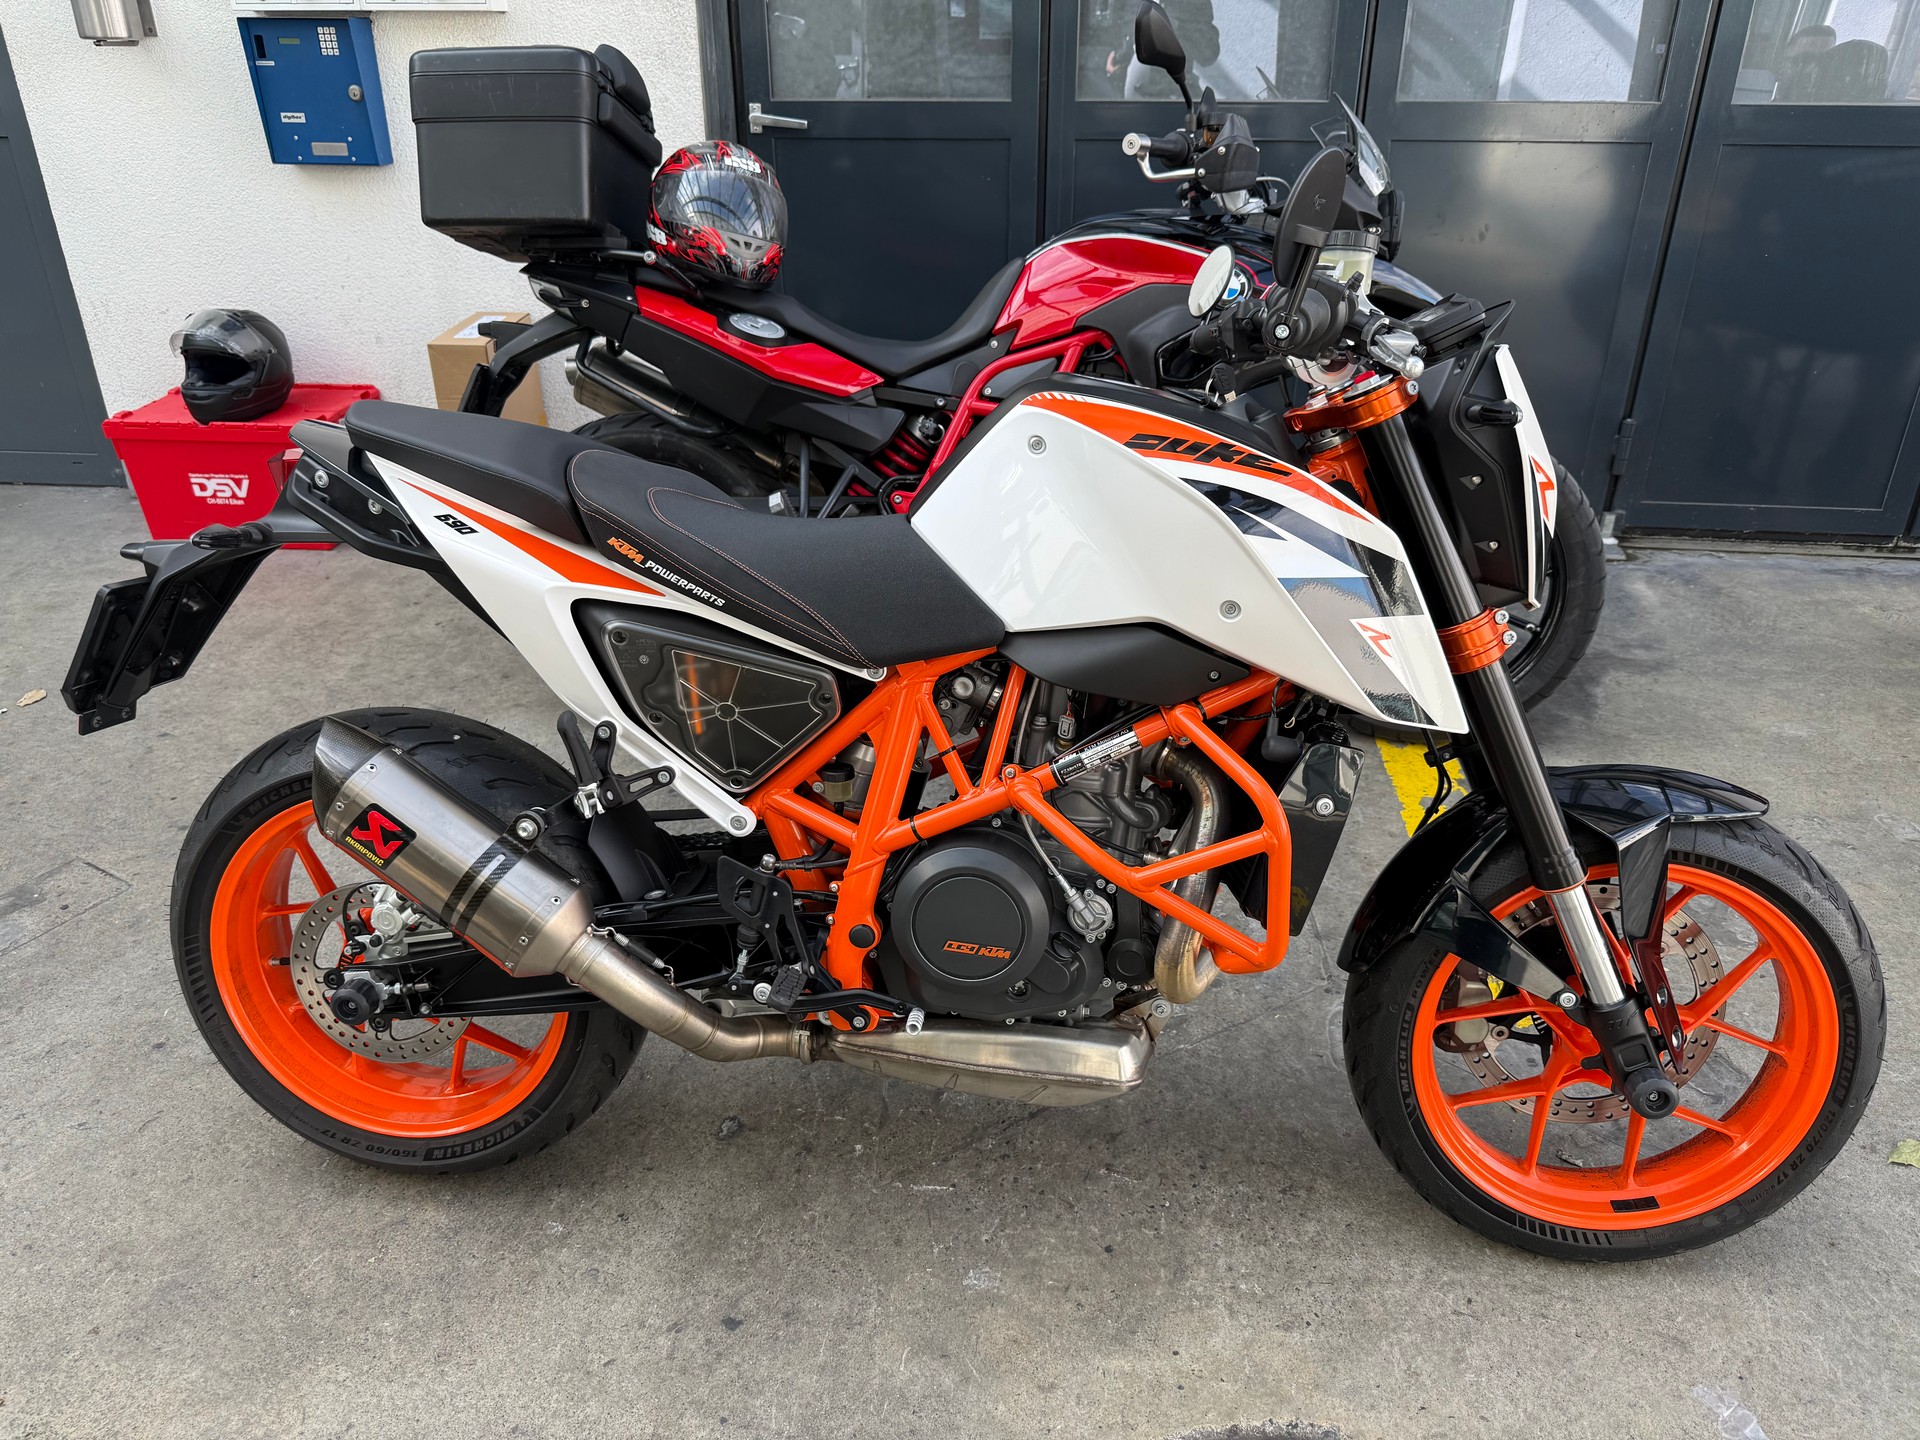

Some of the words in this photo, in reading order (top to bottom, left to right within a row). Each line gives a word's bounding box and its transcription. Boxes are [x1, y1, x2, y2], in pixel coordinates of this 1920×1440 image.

[1122, 433, 1293, 477] DUKE
[190, 477, 250, 498] DSV
[433, 514, 480, 535] 690
[978, 946, 1012, 959] KTM
[1399, 1007, 1414, 1094] MICHELIN
[1835, 1012, 1857, 1101] MICHELIN
[320, 1128, 337, 1139] 17
[431, 1123, 517, 1159] MICHELIN
[1805, 1109, 1837, 1154] 120/70
[366, 1144, 418, 1158] 160/60
[1776, 1170, 1789, 1185] 17
